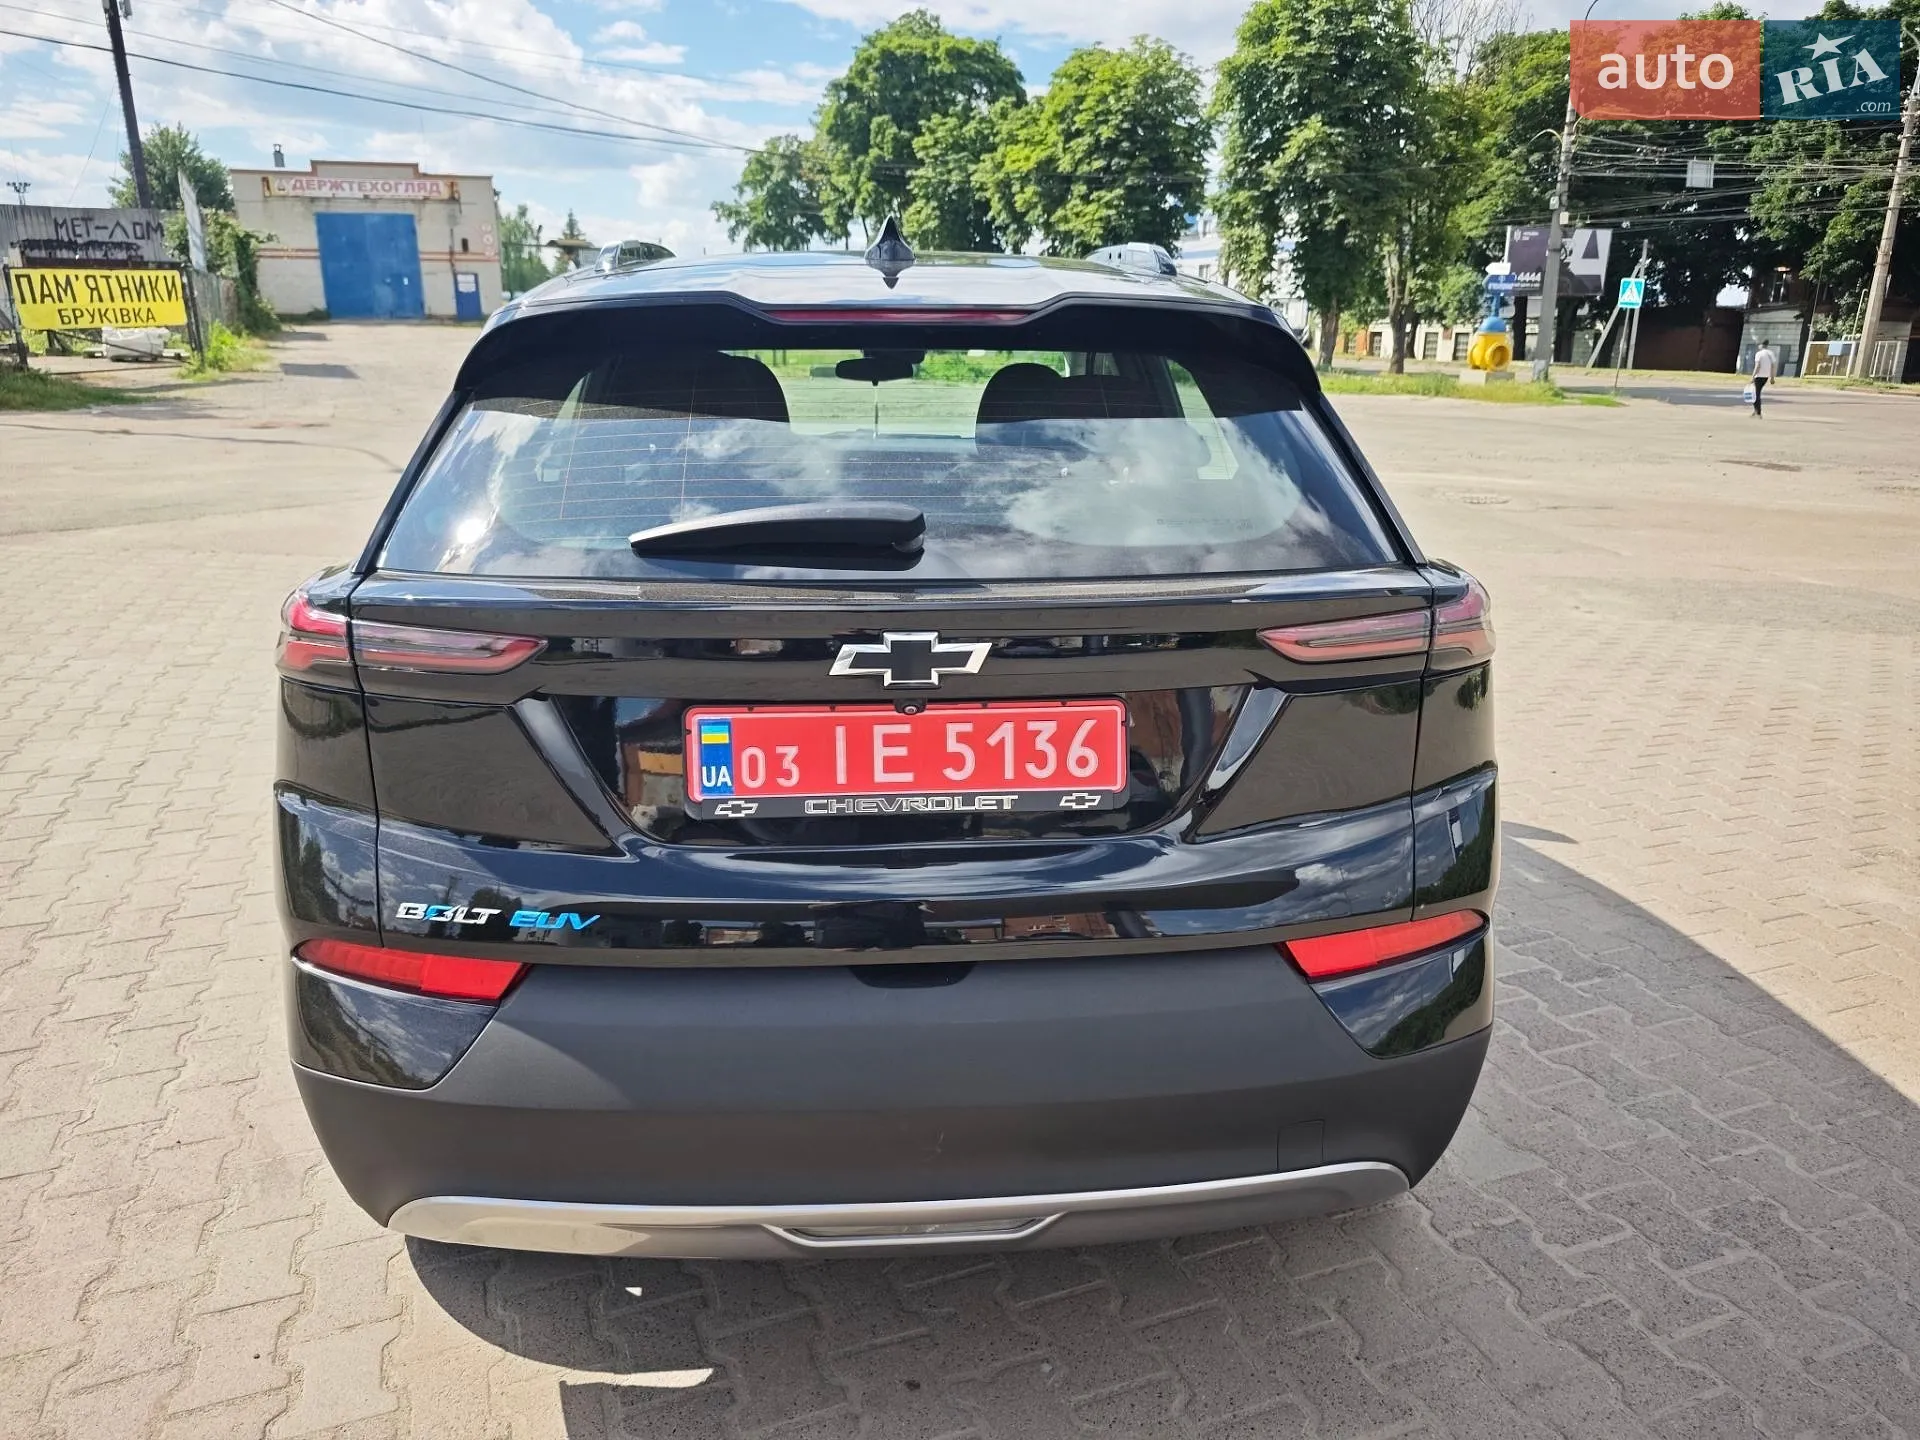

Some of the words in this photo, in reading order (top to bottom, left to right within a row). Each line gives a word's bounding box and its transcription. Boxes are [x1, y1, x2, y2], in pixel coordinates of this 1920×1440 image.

[291, 177, 442, 196] ДЕРЖТЕХОГЛЯД
[14, 273, 180, 305] ПАМ'ЯТНИКИ
[57, 307, 157, 326] БРУКІВКА
[702, 766, 732, 788] UA
[741, 745, 801, 789] 03
[835, 723, 915, 786] IE
[942, 718, 1100, 782] 5136
[804, 794, 1018, 815] CHEVROLET
[395, 902, 502, 925] BOLT
[509, 909, 601, 931] EUV
